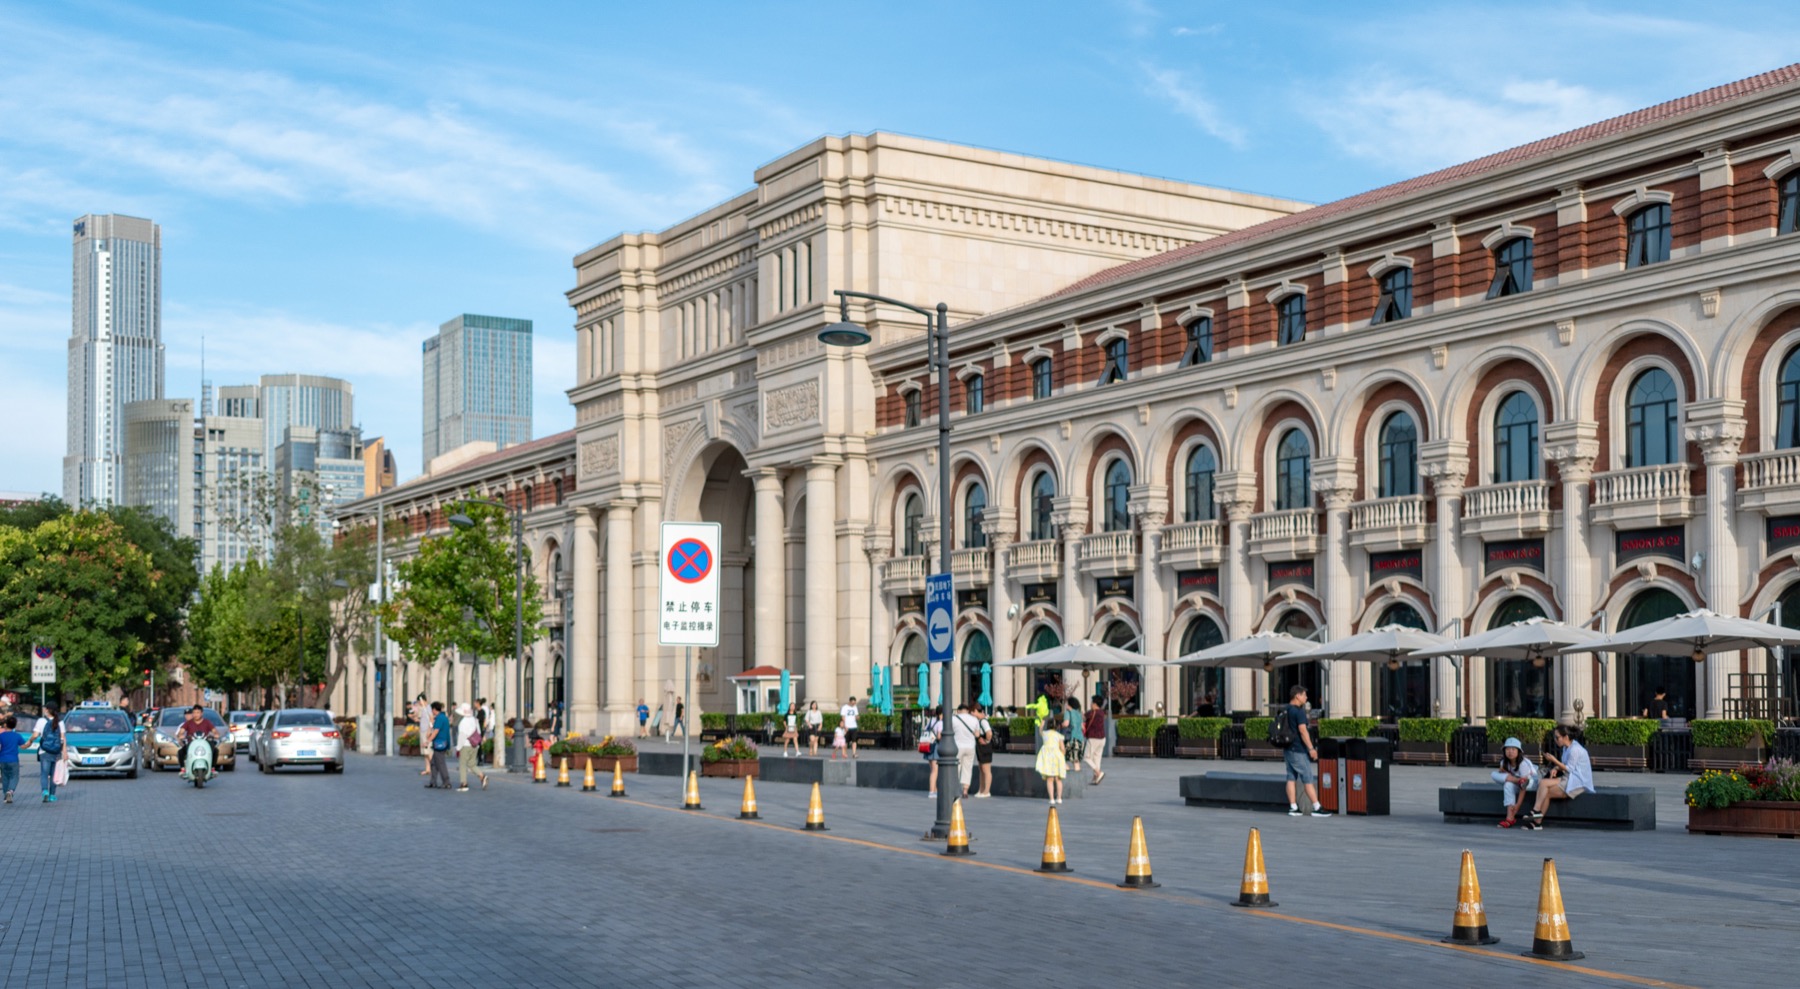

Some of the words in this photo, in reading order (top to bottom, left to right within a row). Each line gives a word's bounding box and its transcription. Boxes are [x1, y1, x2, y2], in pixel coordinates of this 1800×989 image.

[1773, 526, 1800, 538] SMO
[926, 581, 935, 603] P
[665, 600, 713, 613] 禁止停车
